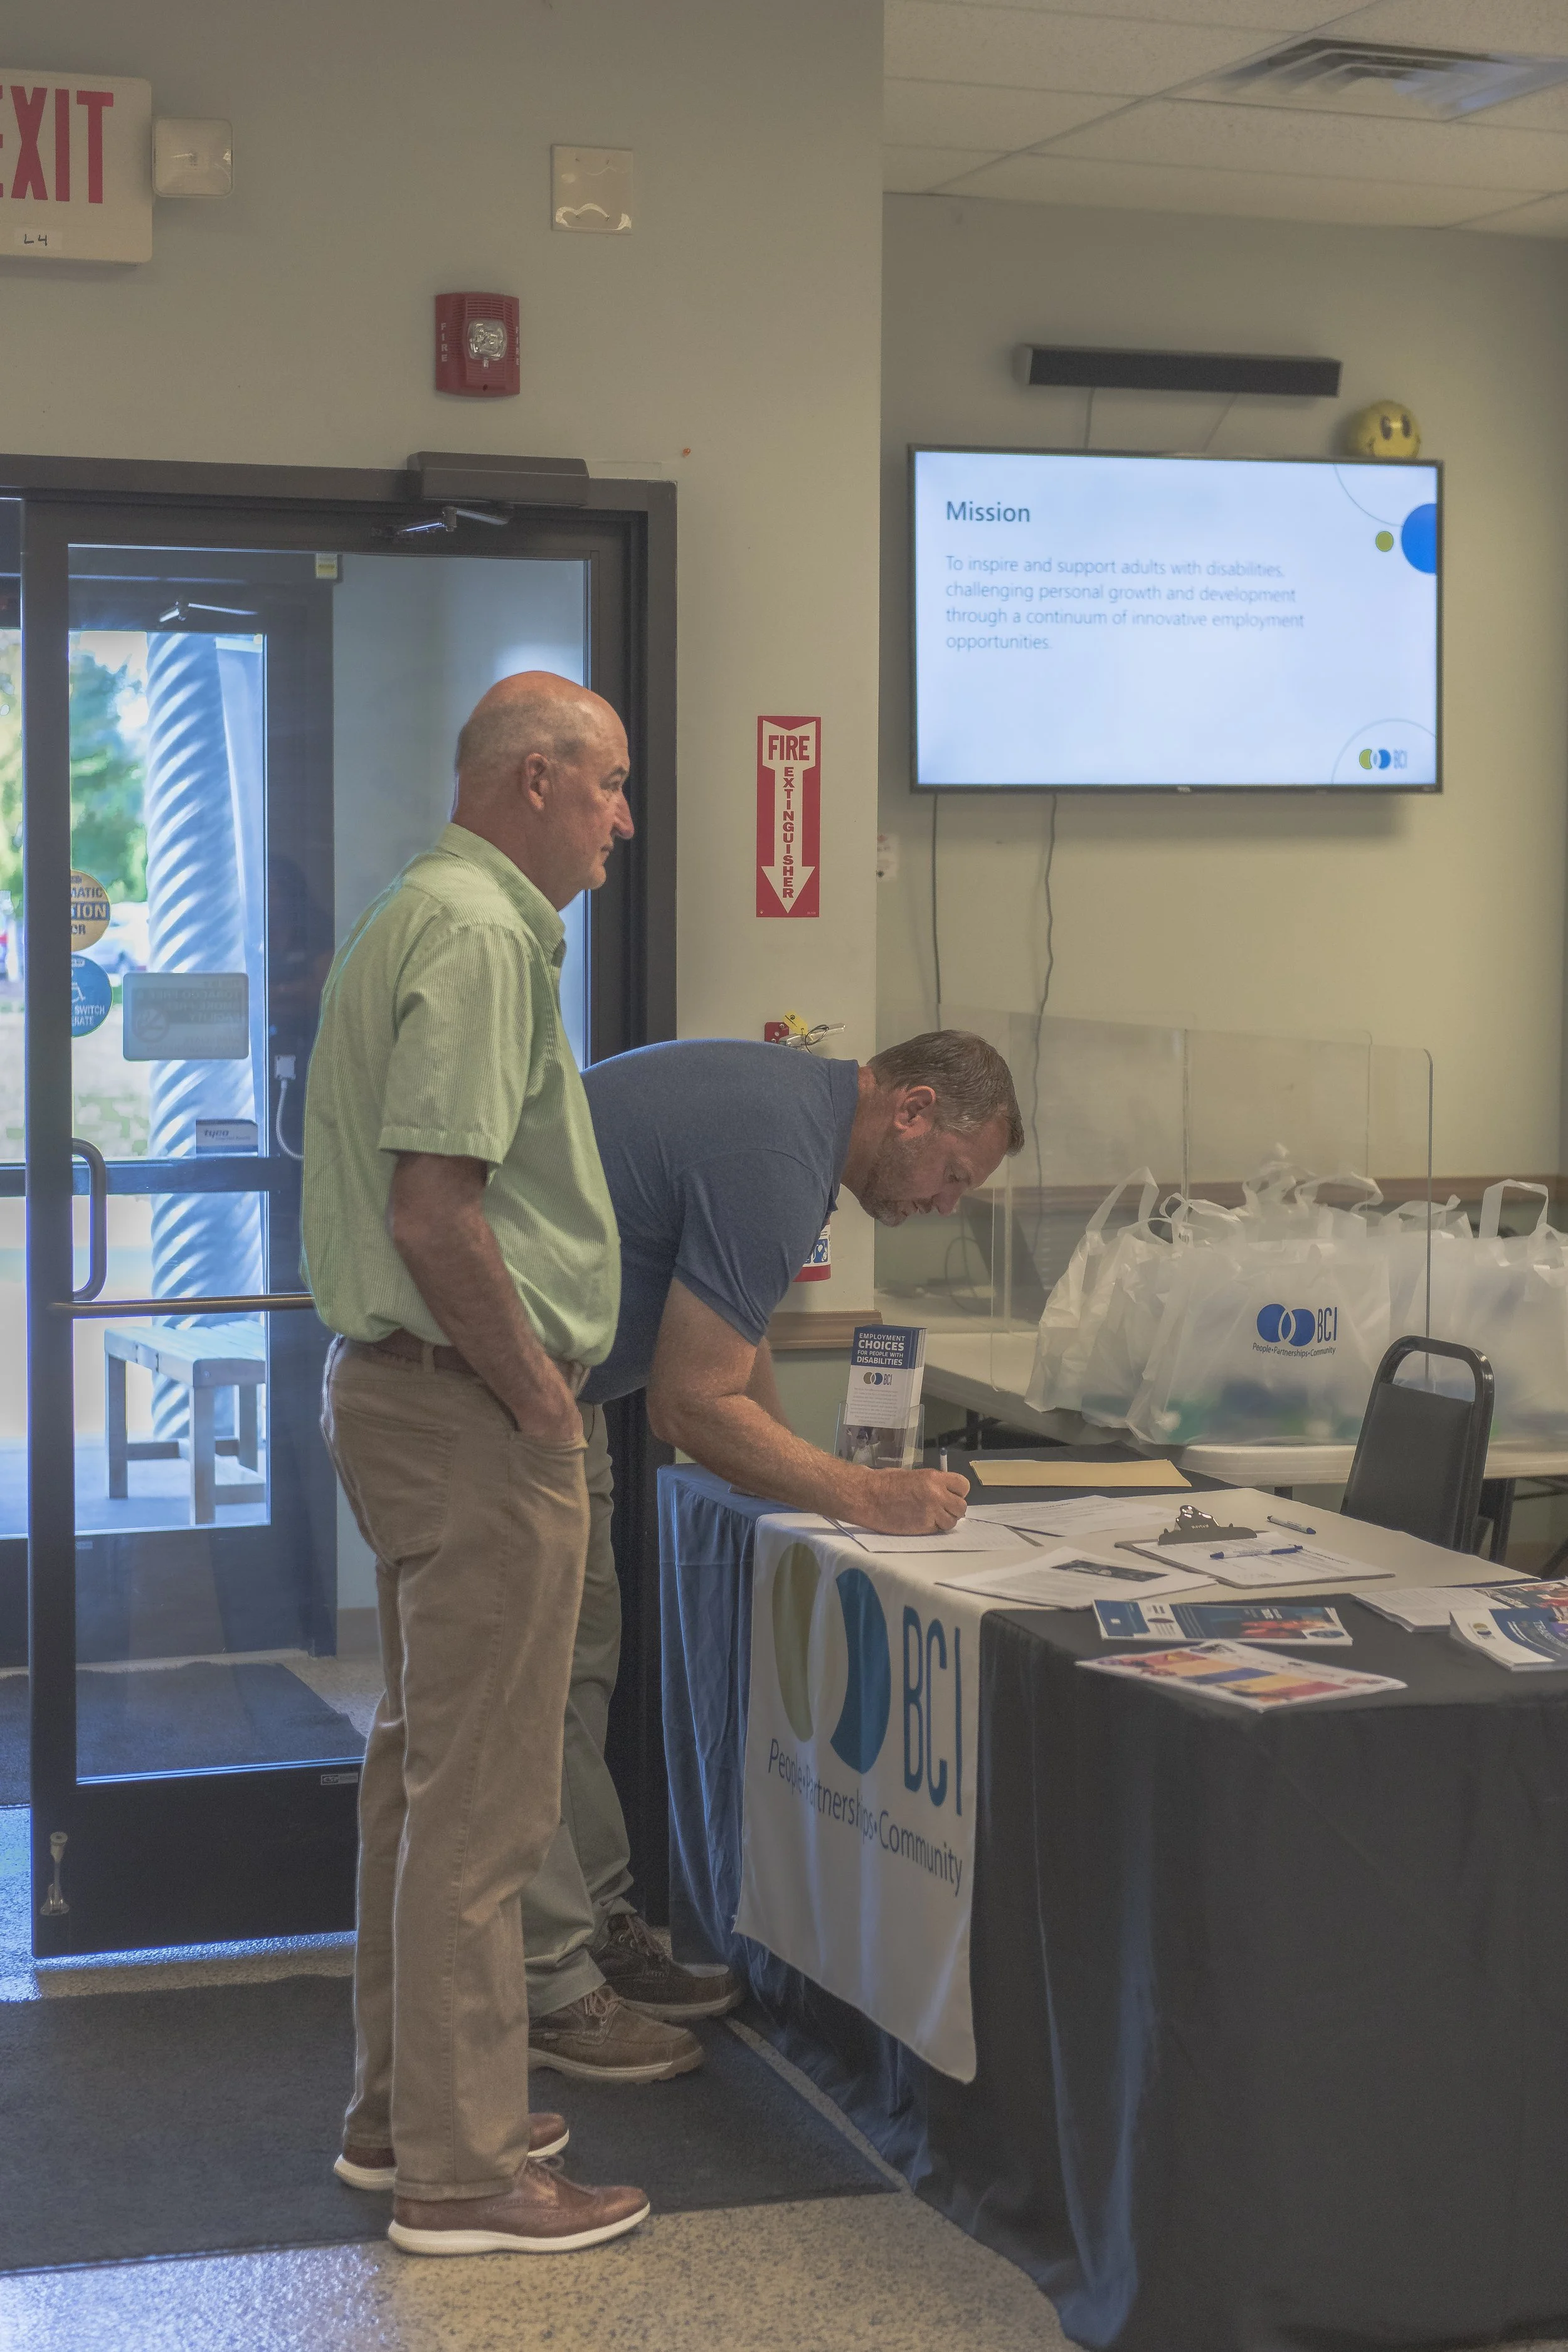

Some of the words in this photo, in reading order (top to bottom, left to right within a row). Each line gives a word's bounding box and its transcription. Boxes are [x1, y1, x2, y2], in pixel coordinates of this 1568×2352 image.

[0, 85, 114, 204] XIT
[946, 501, 1030, 522] Mission
[946, 555, 964, 571] To
[968, 556, 1019, 575] inspire
[1024, 558, 1052, 573] and
[1057, 561, 1116, 578] support
[1121, 559, 1167, 575] adults
[1170, 559, 1202, 576] with
[945, 581, 1034, 602] challenging
[1039, 583, 1104, 601] personal
[1109, 586, 1162, 603] growth
[1166, 585, 1194, 601] and
[1199, 586, 1296, 604] development
[945, 607, 1007, 627] through
[1012, 612, 1022, 623] a
[1025, 608, 1108, 625] continuum
[1112, 609, 1128, 625] of
[1131, 610, 1207, 627] innovative
[1212, 612, 1305, 631] employment
[768, 734, 810, 761] FIRE
[783, 766, 795, 898] EXTINGUISHER
[75, 1005, 105, 1015] SWITCH
[1317, 1306, 1337, 1343] BCI
[858, 1340, 904, 1352] CHOICES
[859, 1333, 906, 1342] EMPLOYMENT
[857, 1356, 903, 1366] DISABILITIES
[883, 1374, 893, 1385] BCI
[903, 1604, 963, 1817] BCI
